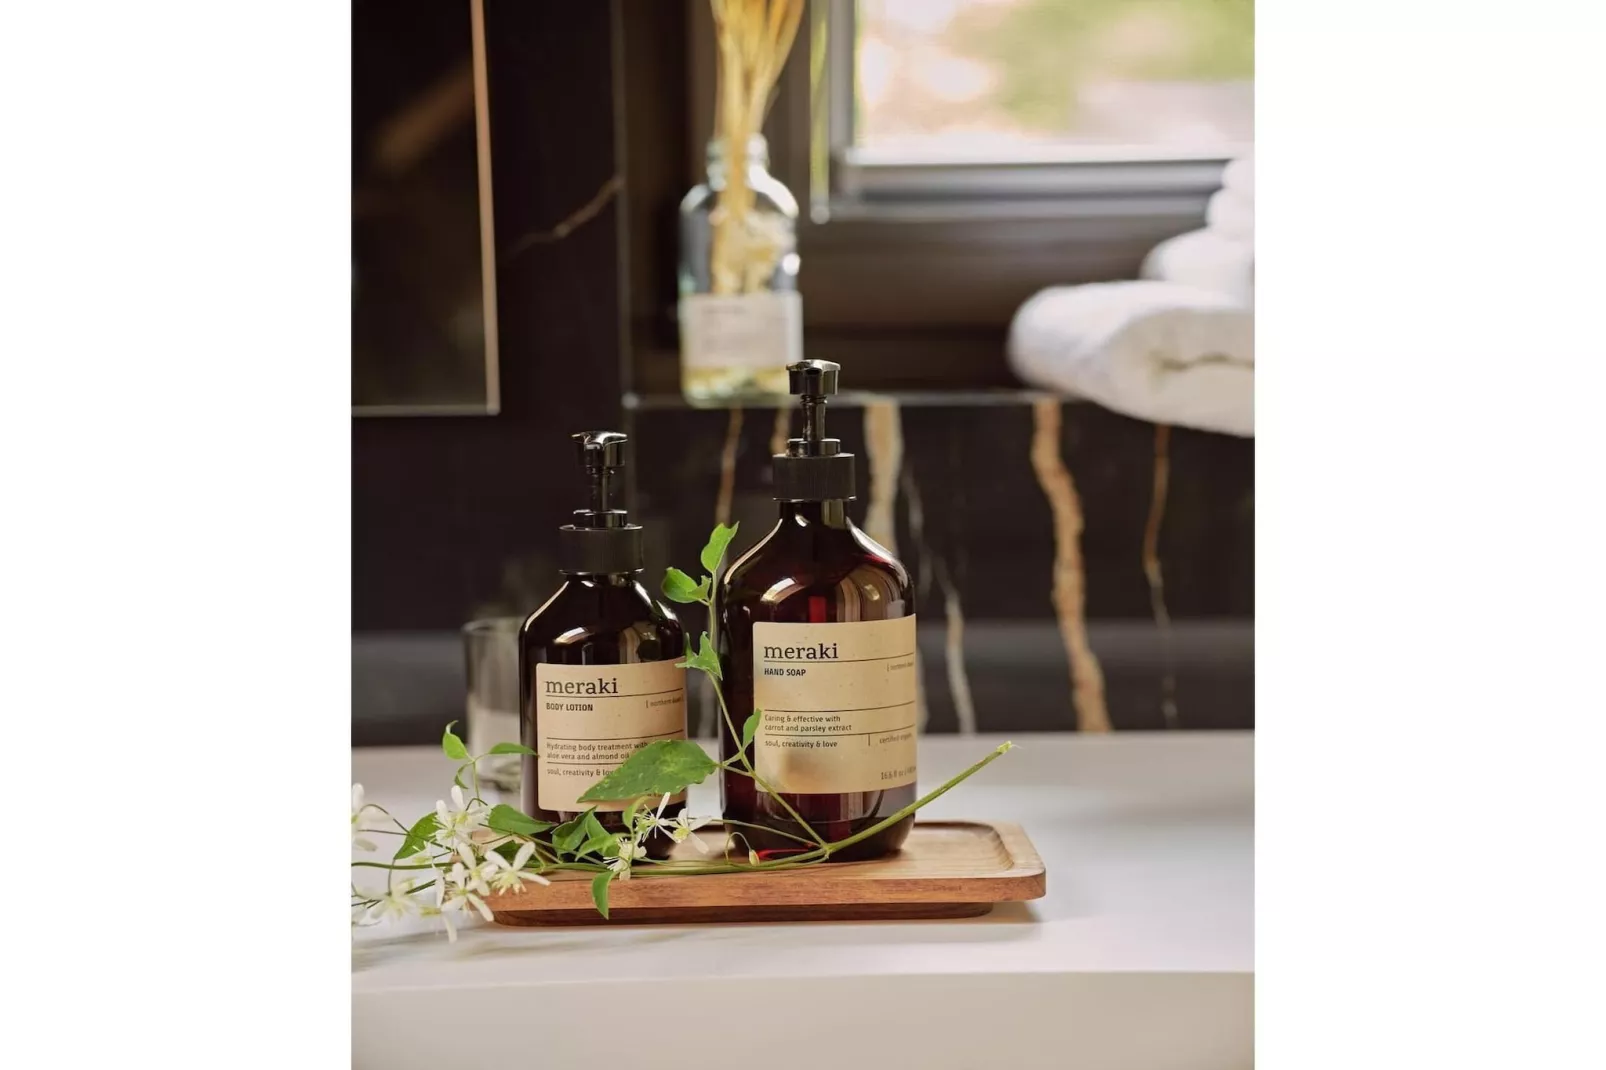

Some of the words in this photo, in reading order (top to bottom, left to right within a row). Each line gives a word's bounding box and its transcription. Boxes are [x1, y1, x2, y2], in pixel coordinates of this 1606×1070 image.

[764, 642, 838, 659] meraki
[764, 667, 784, 676] HAND
[786, 668, 806, 677] SOAP
[545, 677, 618, 694] meraki
[546, 702, 563, 711] BODY
[565, 703, 593, 712] LOTION
[764, 714, 785, 723] Caring
[786, 714, 792, 722] &
[793, 714, 824, 723] effective
[785, 724, 799, 732] and
[800, 724, 826, 733] parsley
[828, 724, 852, 732] extract
[578, 742, 596, 752] body
[597, 742, 632, 751] treatment
[765, 739, 781, 748] soul,
[781, 740, 814, 749] creativity
[815, 740, 821, 748] &
[822, 740, 838, 748] love
[576, 752, 591, 761] and
[591, 752, 619, 761] almond
[562, 768, 595, 778] creativity
[595, 768, 601, 776] &
[602, 768, 615, 777] lov
